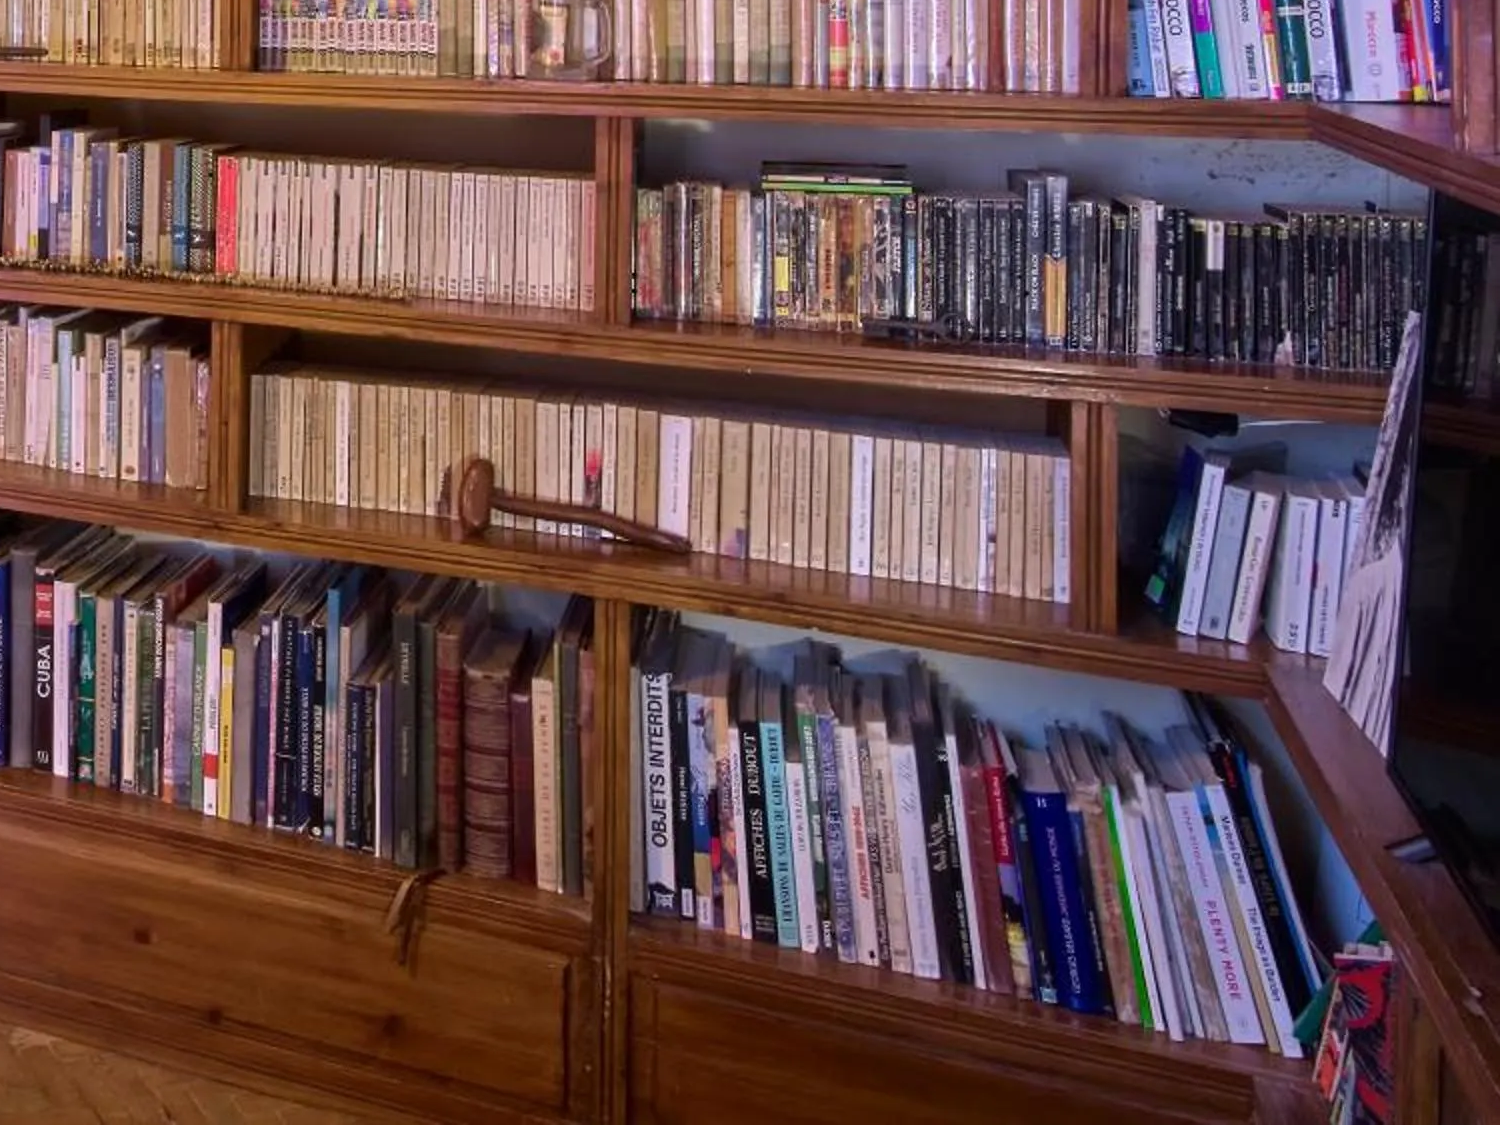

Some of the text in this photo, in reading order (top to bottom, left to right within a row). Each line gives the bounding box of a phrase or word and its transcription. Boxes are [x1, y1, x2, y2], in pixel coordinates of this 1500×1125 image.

[36, 644, 52, 698] CUBA
[645, 672, 668, 848] OBJETS INTERDITS
[743, 731, 769, 879] AFFICHES DUBOUT
[1204, 899, 1242, 1001] PLENTY MORE
